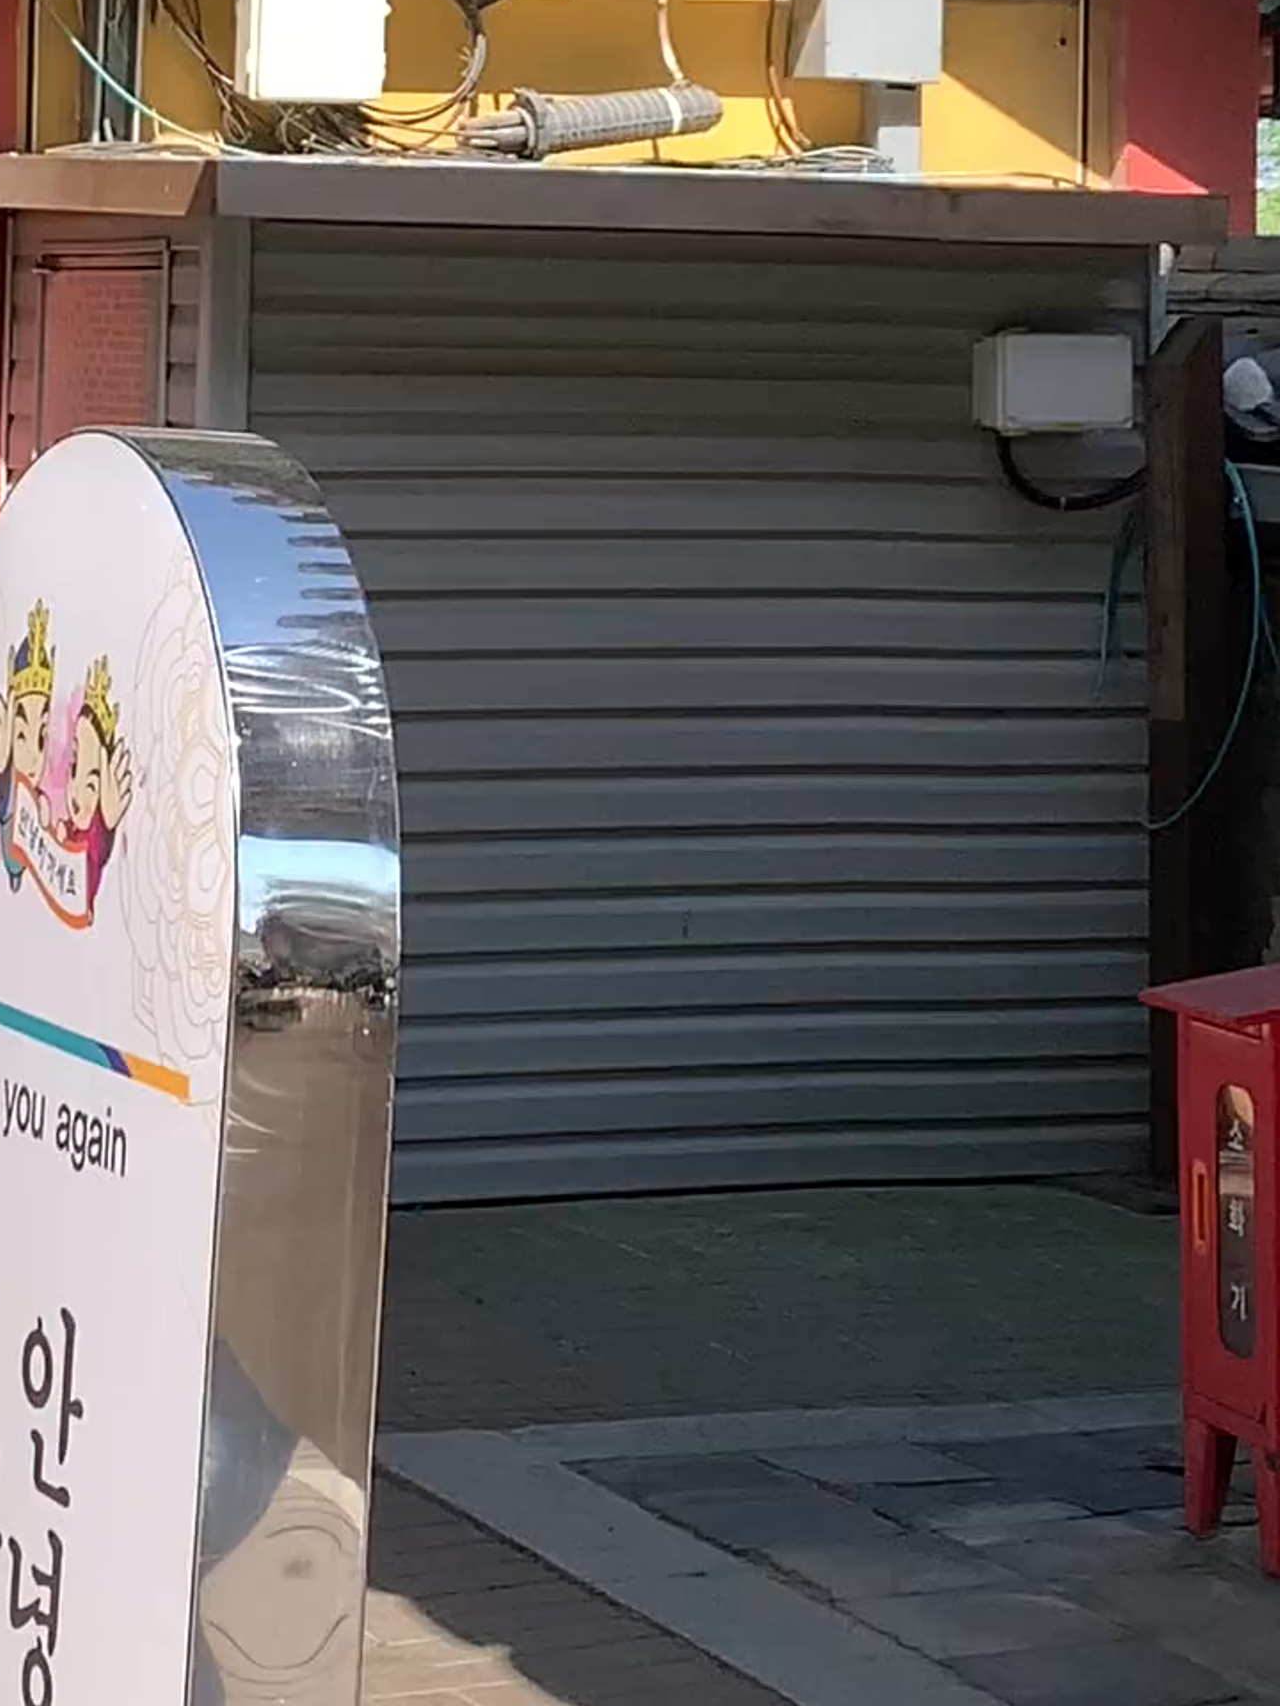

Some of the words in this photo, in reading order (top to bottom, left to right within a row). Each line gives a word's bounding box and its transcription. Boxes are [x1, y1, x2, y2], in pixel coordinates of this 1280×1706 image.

[3, 1079, 46, 1141] you
[55, 1099, 127, 1178] again
[1228, 1119, 1246, 1321] 소화기
